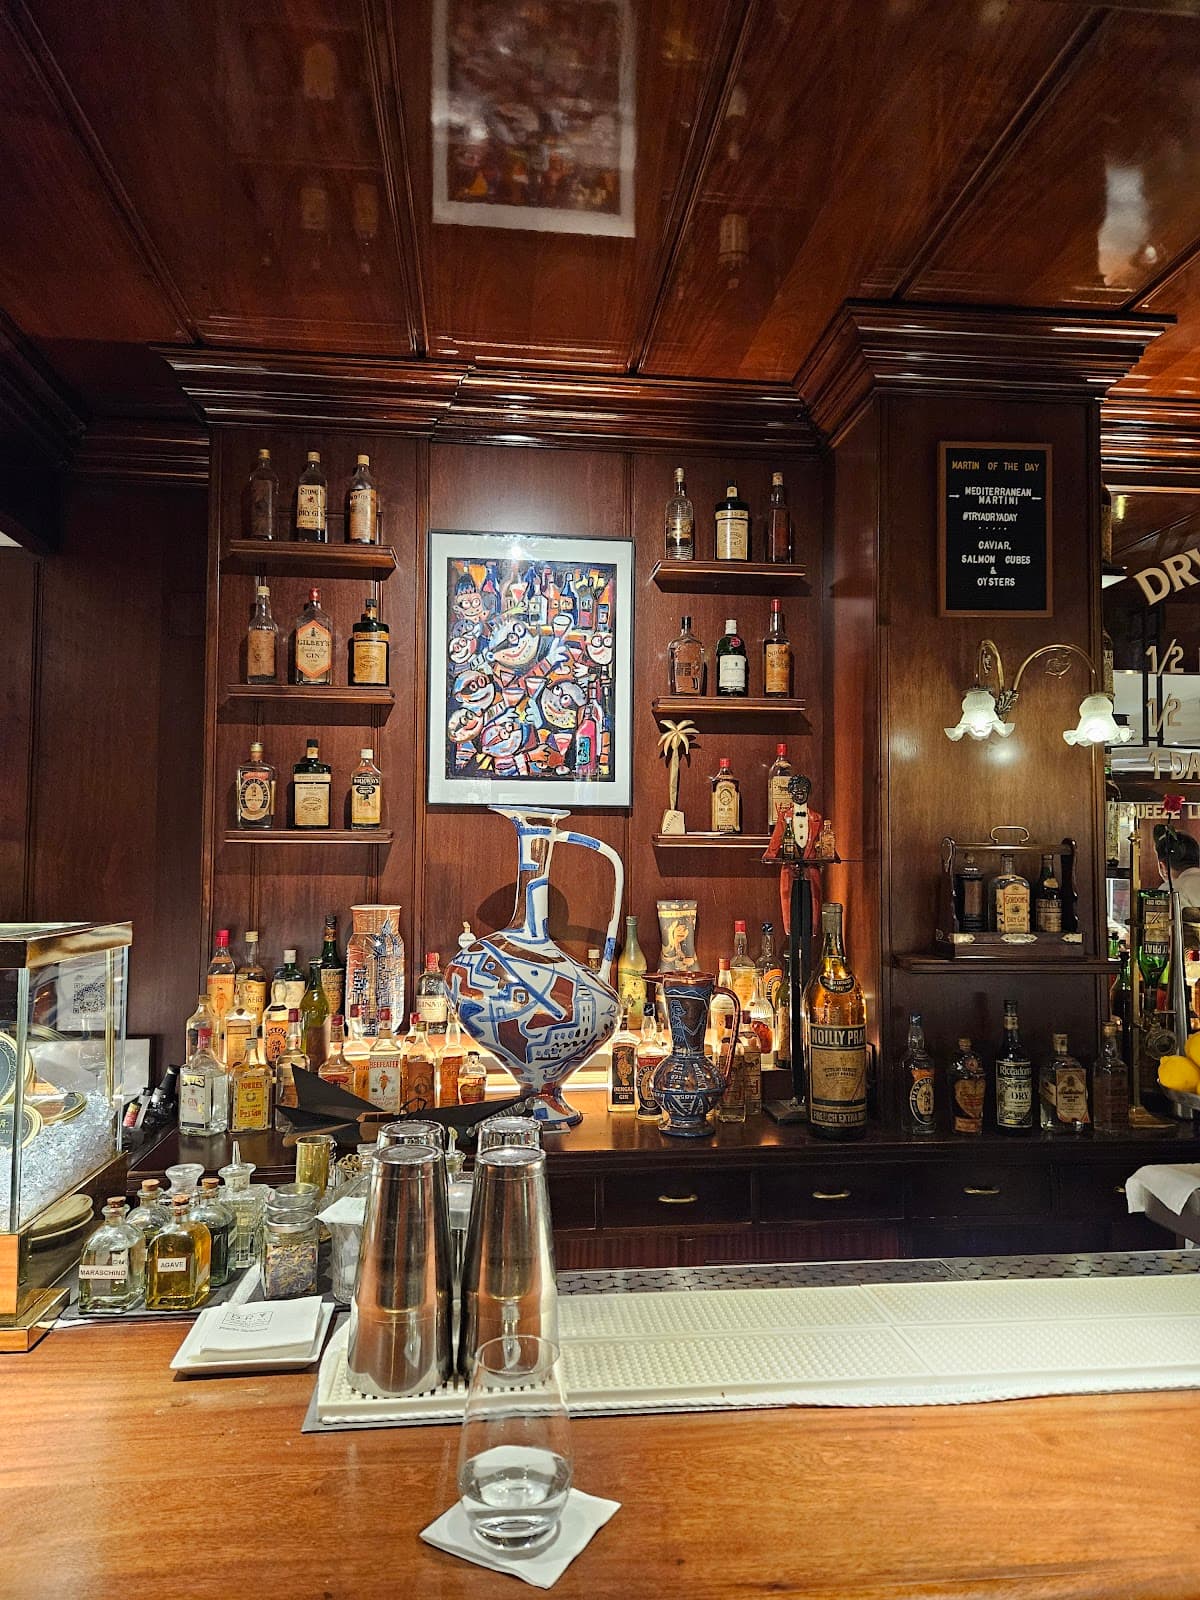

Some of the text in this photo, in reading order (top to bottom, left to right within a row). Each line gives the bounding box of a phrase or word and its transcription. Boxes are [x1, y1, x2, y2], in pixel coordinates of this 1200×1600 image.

[952, 460, 1040, 472] MARTIN OF THE DAY
[964, 486, 1032, 497] MEDITERRANEAN
[978, 495, 1019, 505] MARTINI
[961, 554, 1031, 565] SALMON CUBES
[989, 566, 998, 575] &
[976, 577, 1016, 587] OYSTERS
[1145, 638, 1184, 677] 1/2
[1146, 693, 1182, 733] 1/2
[812, 1028, 865, 1046] NOILLY PRA
[160, 1261, 184, 1269] AGAVE
[80, 1269, 127, 1277] MARASCHINO
